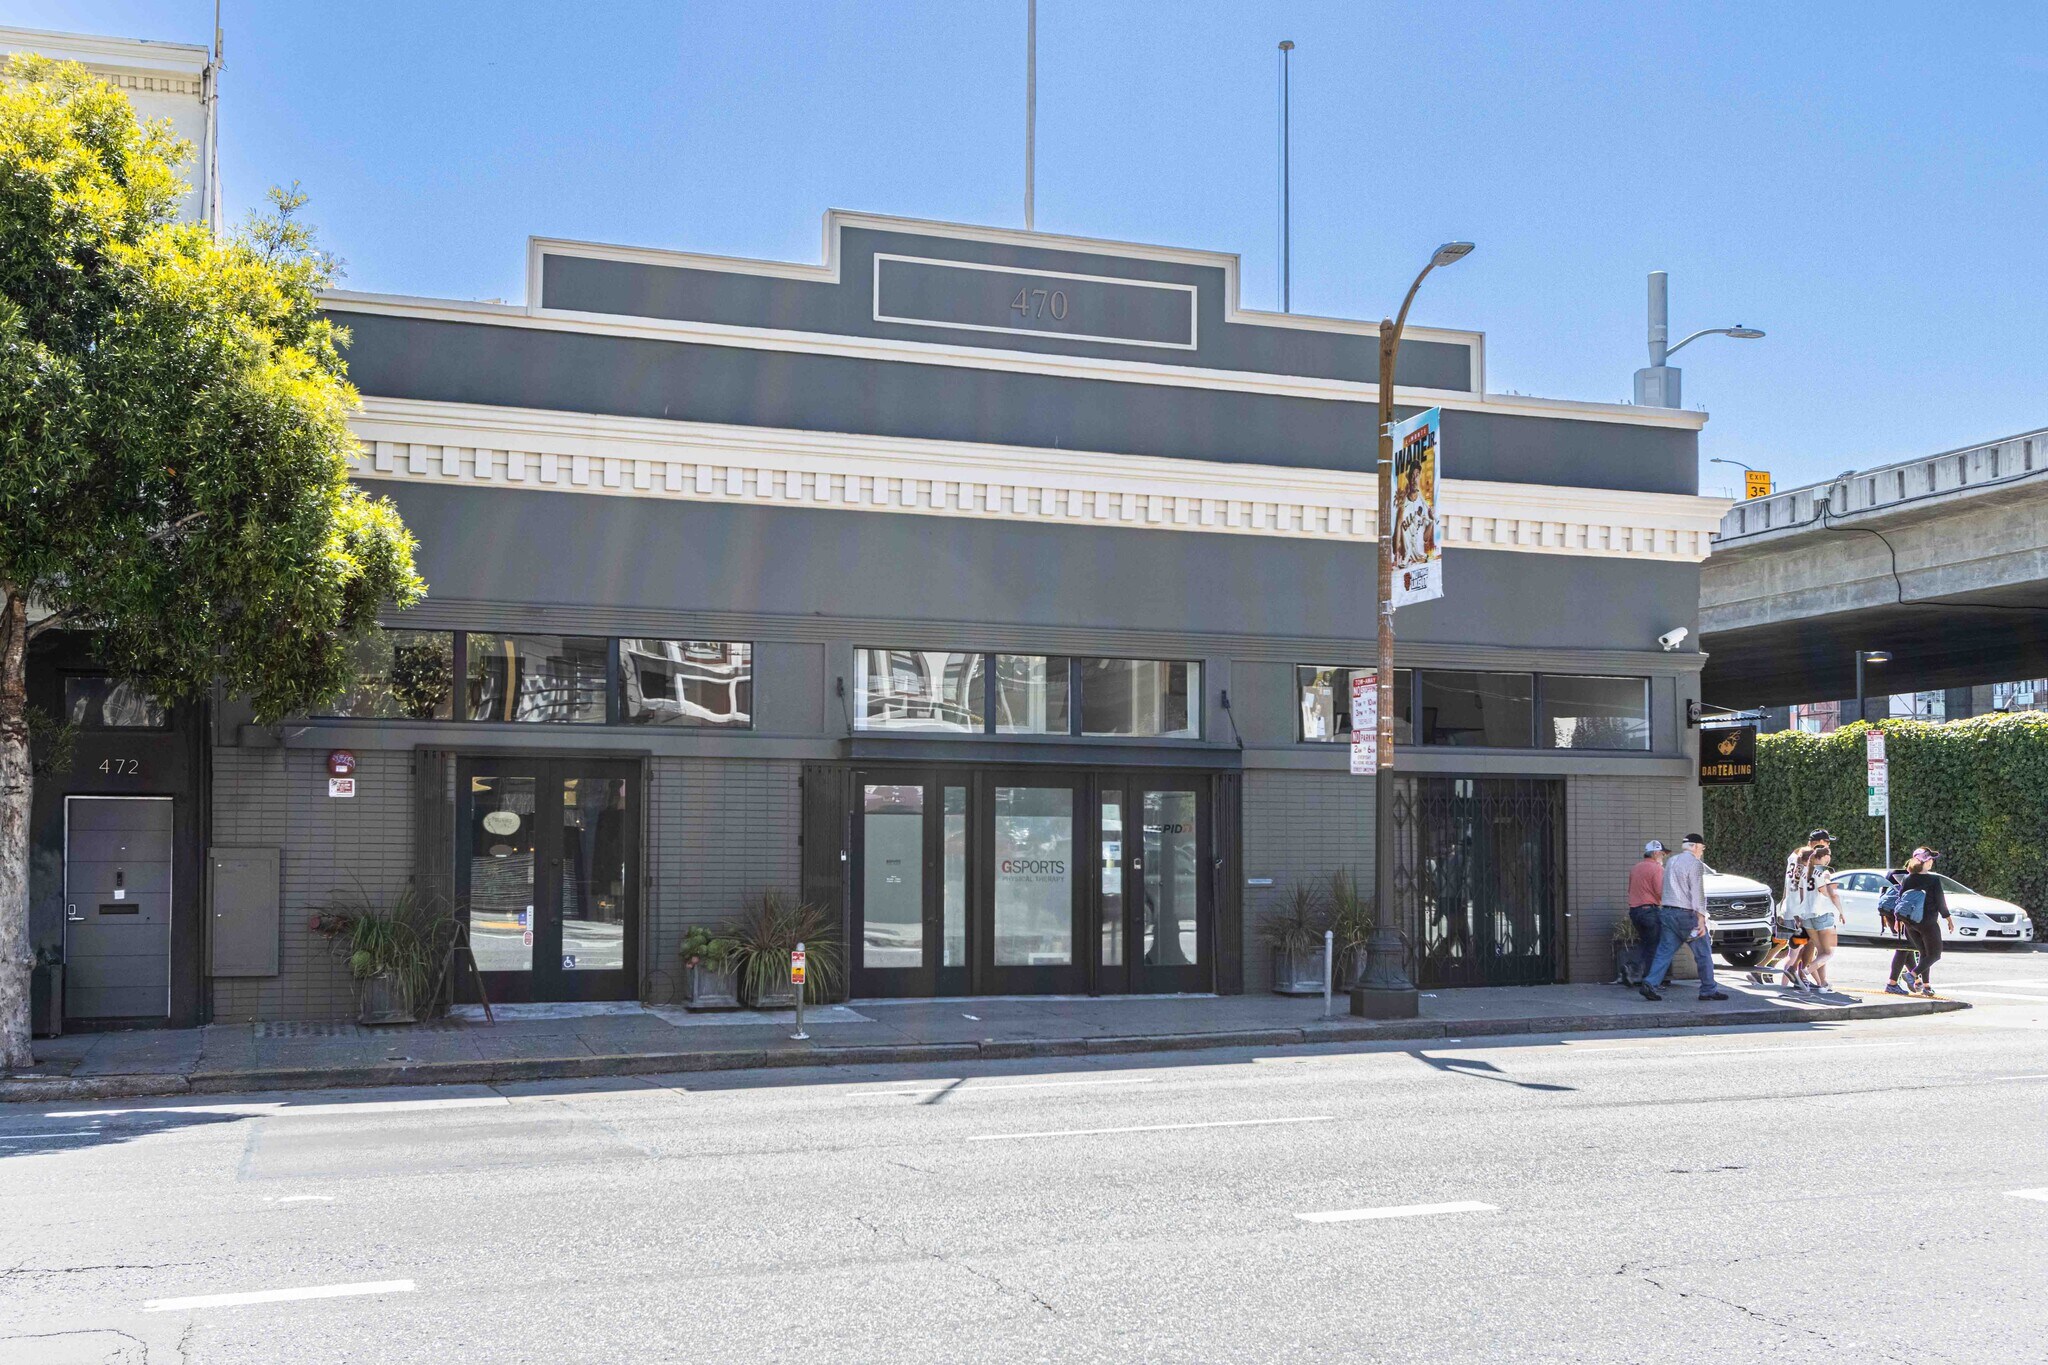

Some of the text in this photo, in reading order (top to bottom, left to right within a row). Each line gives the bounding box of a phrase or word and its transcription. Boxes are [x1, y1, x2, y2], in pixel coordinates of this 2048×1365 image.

[1011, 287, 1068, 320] 470
[1395, 431, 1437, 476] WADE JR.
[1749, 473, 1766, 481] EXIT
[1750, 486, 1767, 497] 35
[1355, 677, 1377, 685] TOW-AWAY
[1353, 685, 1377, 696] NO STOPPIN
[1353, 731, 1376, 743] NO PARKIN
[99, 759, 139, 774] 472
[1701, 764, 1752, 776] DARTEALING
[1001, 860, 1065, 874] GSPORTS
[1035, 875, 1065, 883] THERAPY
